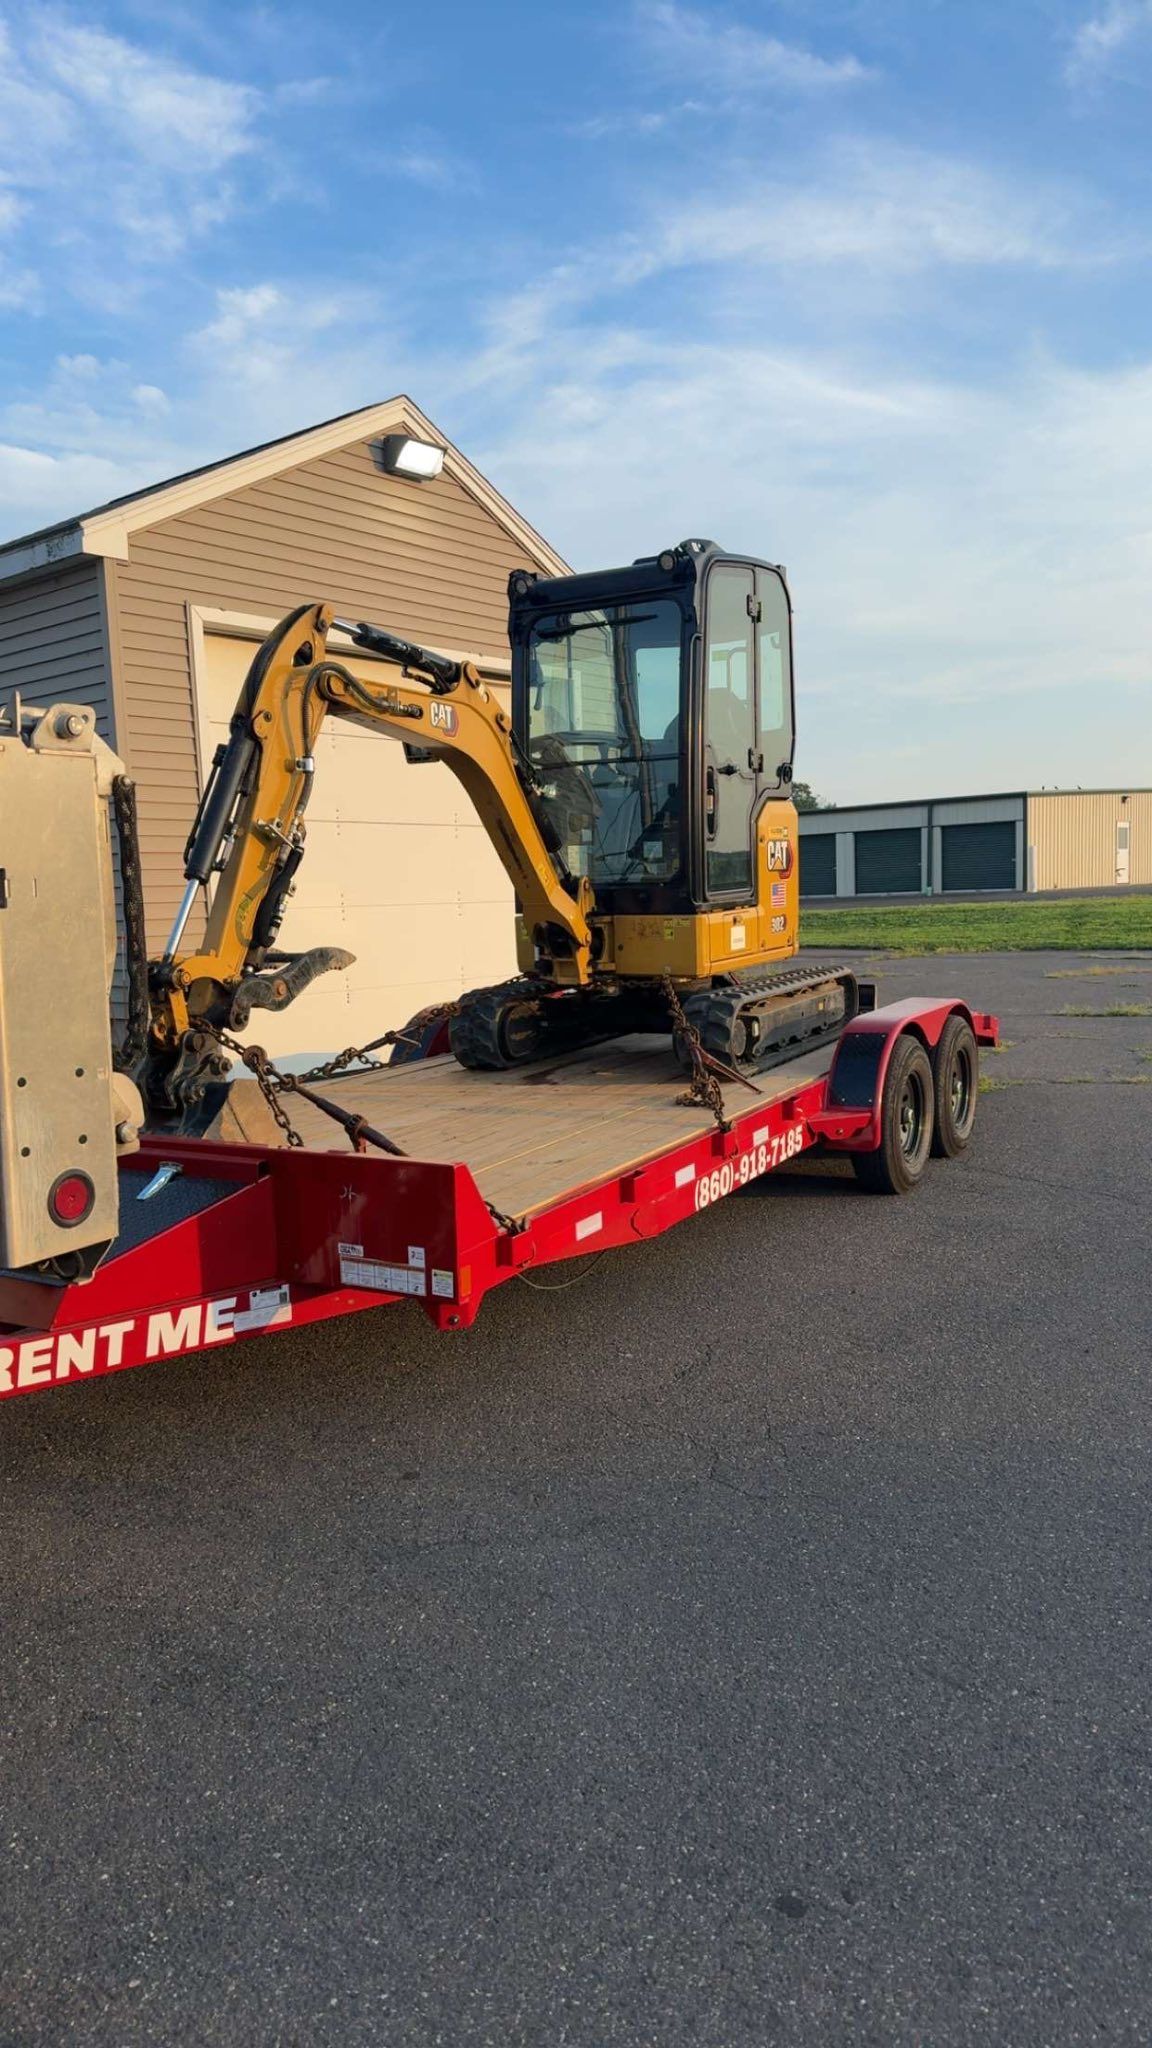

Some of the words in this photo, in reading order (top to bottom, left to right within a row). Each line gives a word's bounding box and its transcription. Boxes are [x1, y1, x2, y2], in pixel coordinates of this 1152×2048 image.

[431, 701, 452, 728] CAT
[767, 841, 788, 870] CAT
[694, 1124, 803, 1212] (860)-918-7185
[146, 1297, 237, 1359] ME
